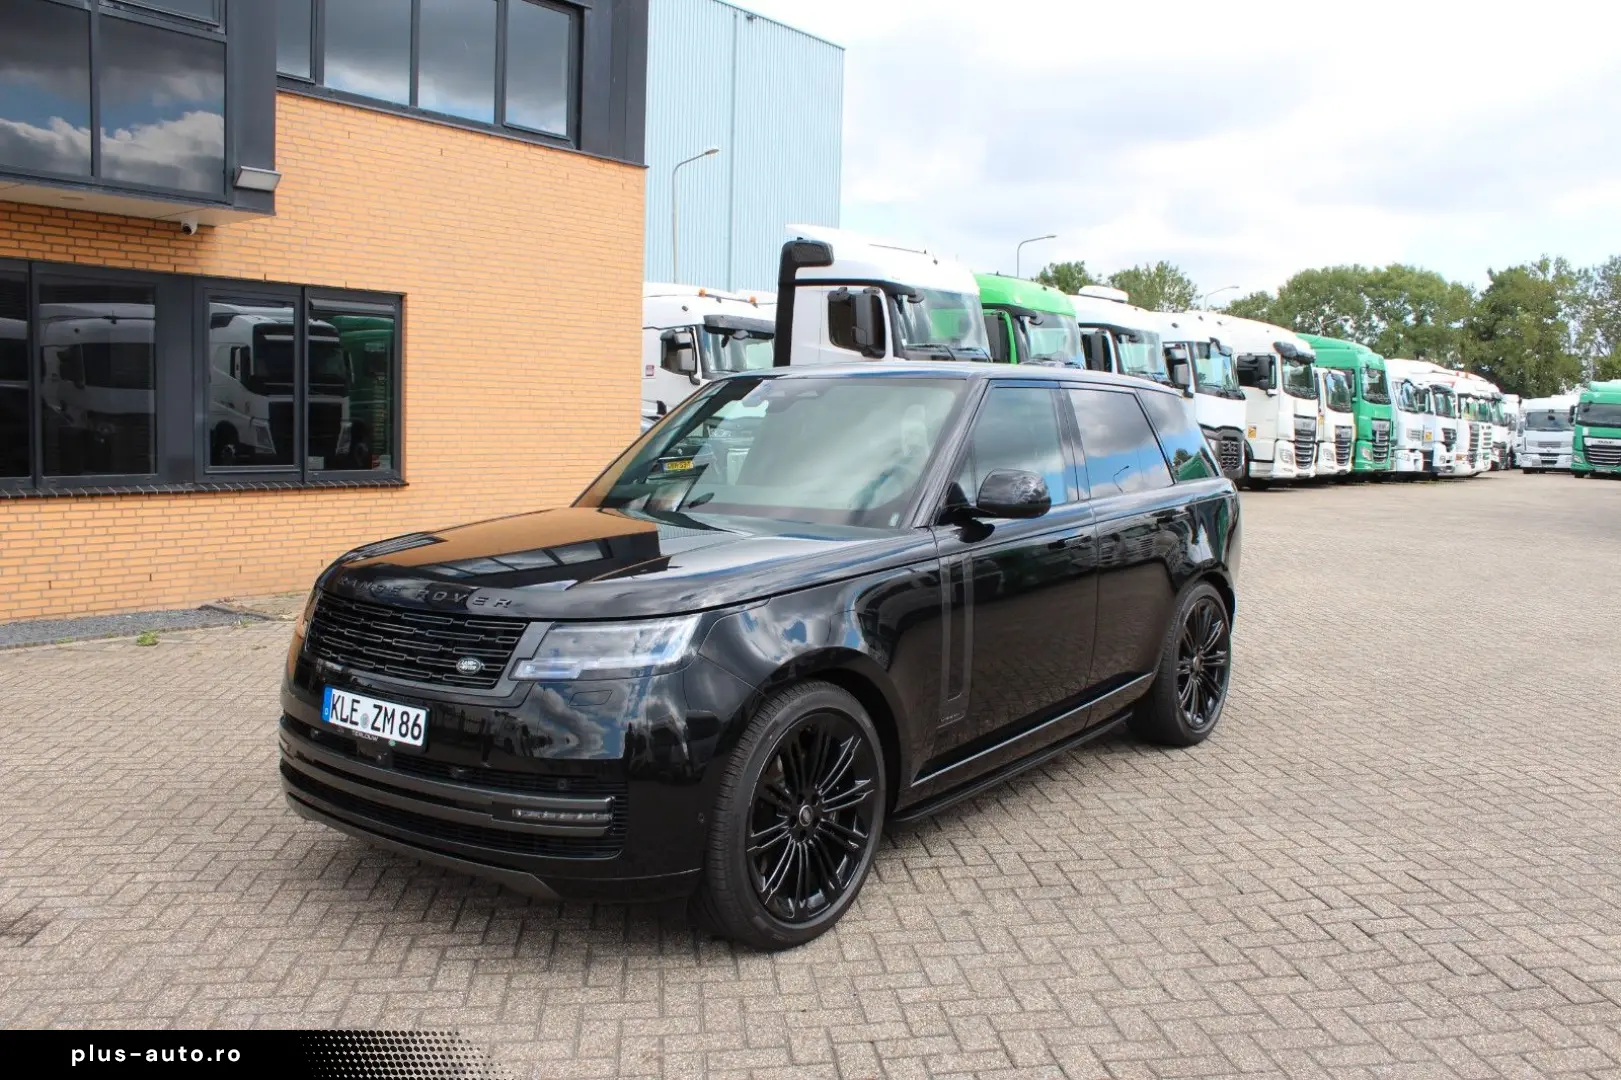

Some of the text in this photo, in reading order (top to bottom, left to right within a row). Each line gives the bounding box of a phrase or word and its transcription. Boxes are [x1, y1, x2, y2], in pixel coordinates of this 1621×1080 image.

[415, 589, 512, 608] ROVER
[331, 694, 422, 741] KLE ZM 86
